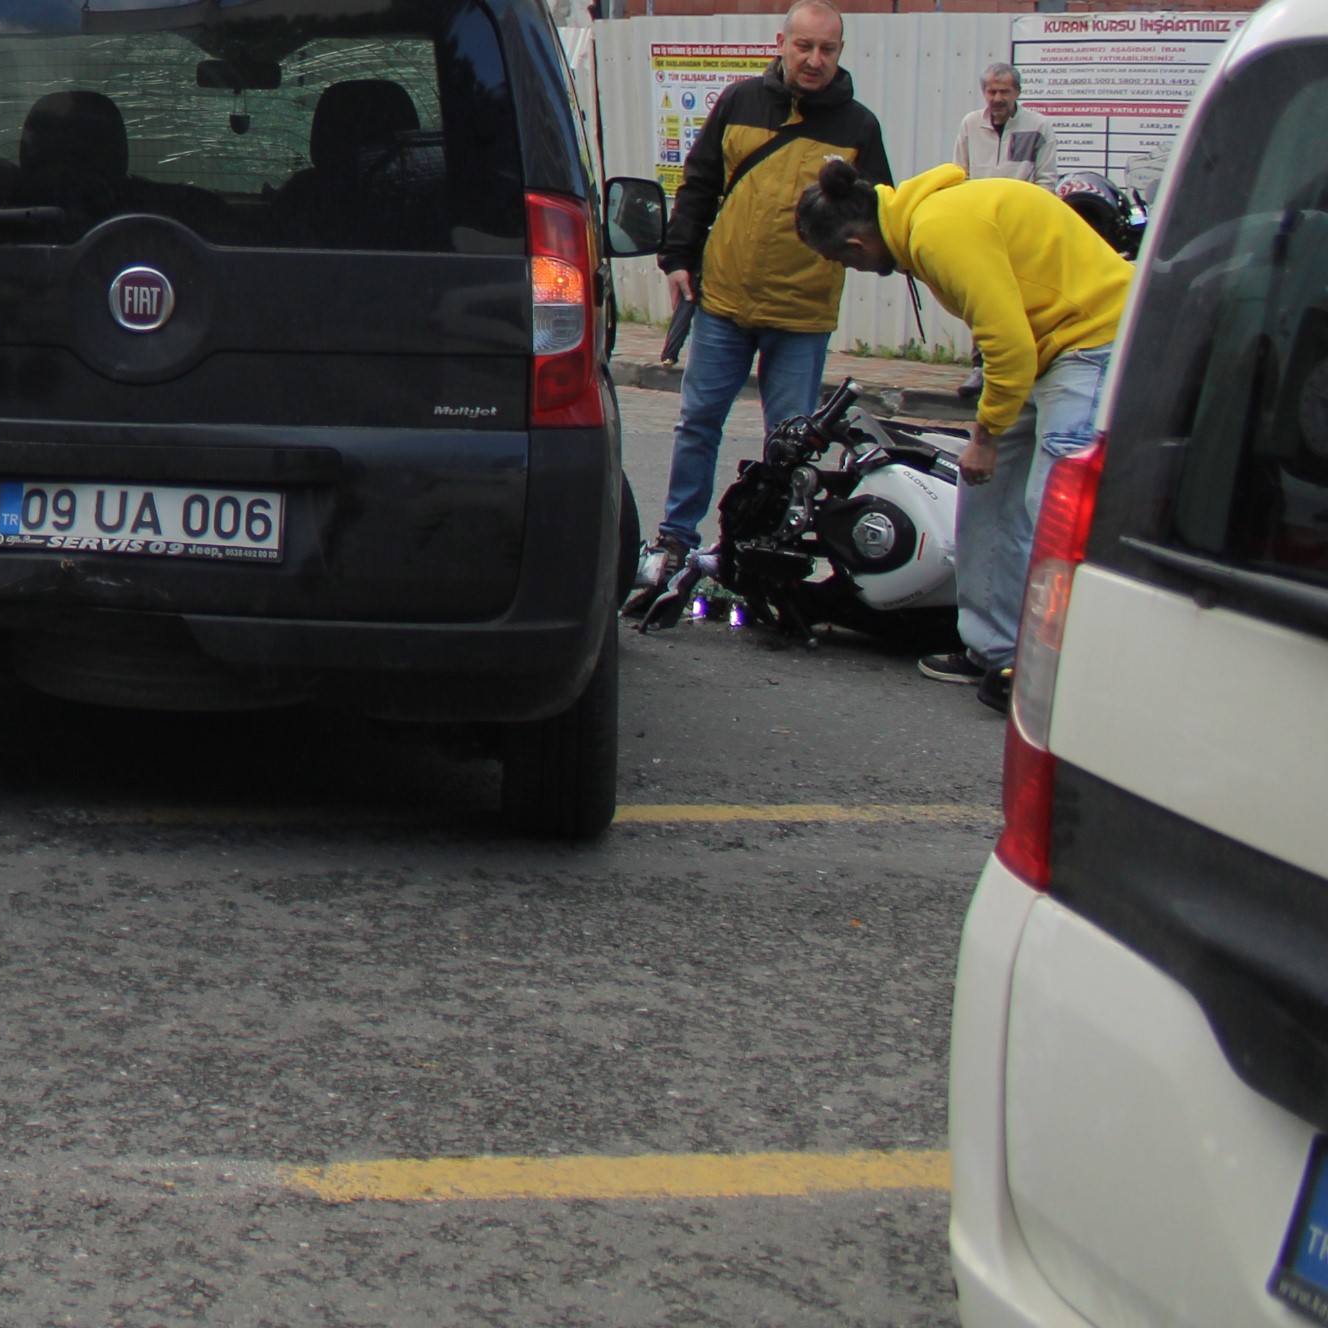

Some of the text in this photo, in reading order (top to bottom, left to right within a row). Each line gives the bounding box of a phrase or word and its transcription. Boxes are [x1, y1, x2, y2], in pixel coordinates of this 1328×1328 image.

[1044, 20, 1088, 34] KURAN
[1092, 19, 1136, 33] KURSU
[124, 285, 161, 315] FIAT
[902, 469, 938, 501] CFMOTO
[1, 488, 273, 543] TR 09 UA 006
[148, 540, 185, 555] 09
[882, 590, 923, 609] CFMOTO
